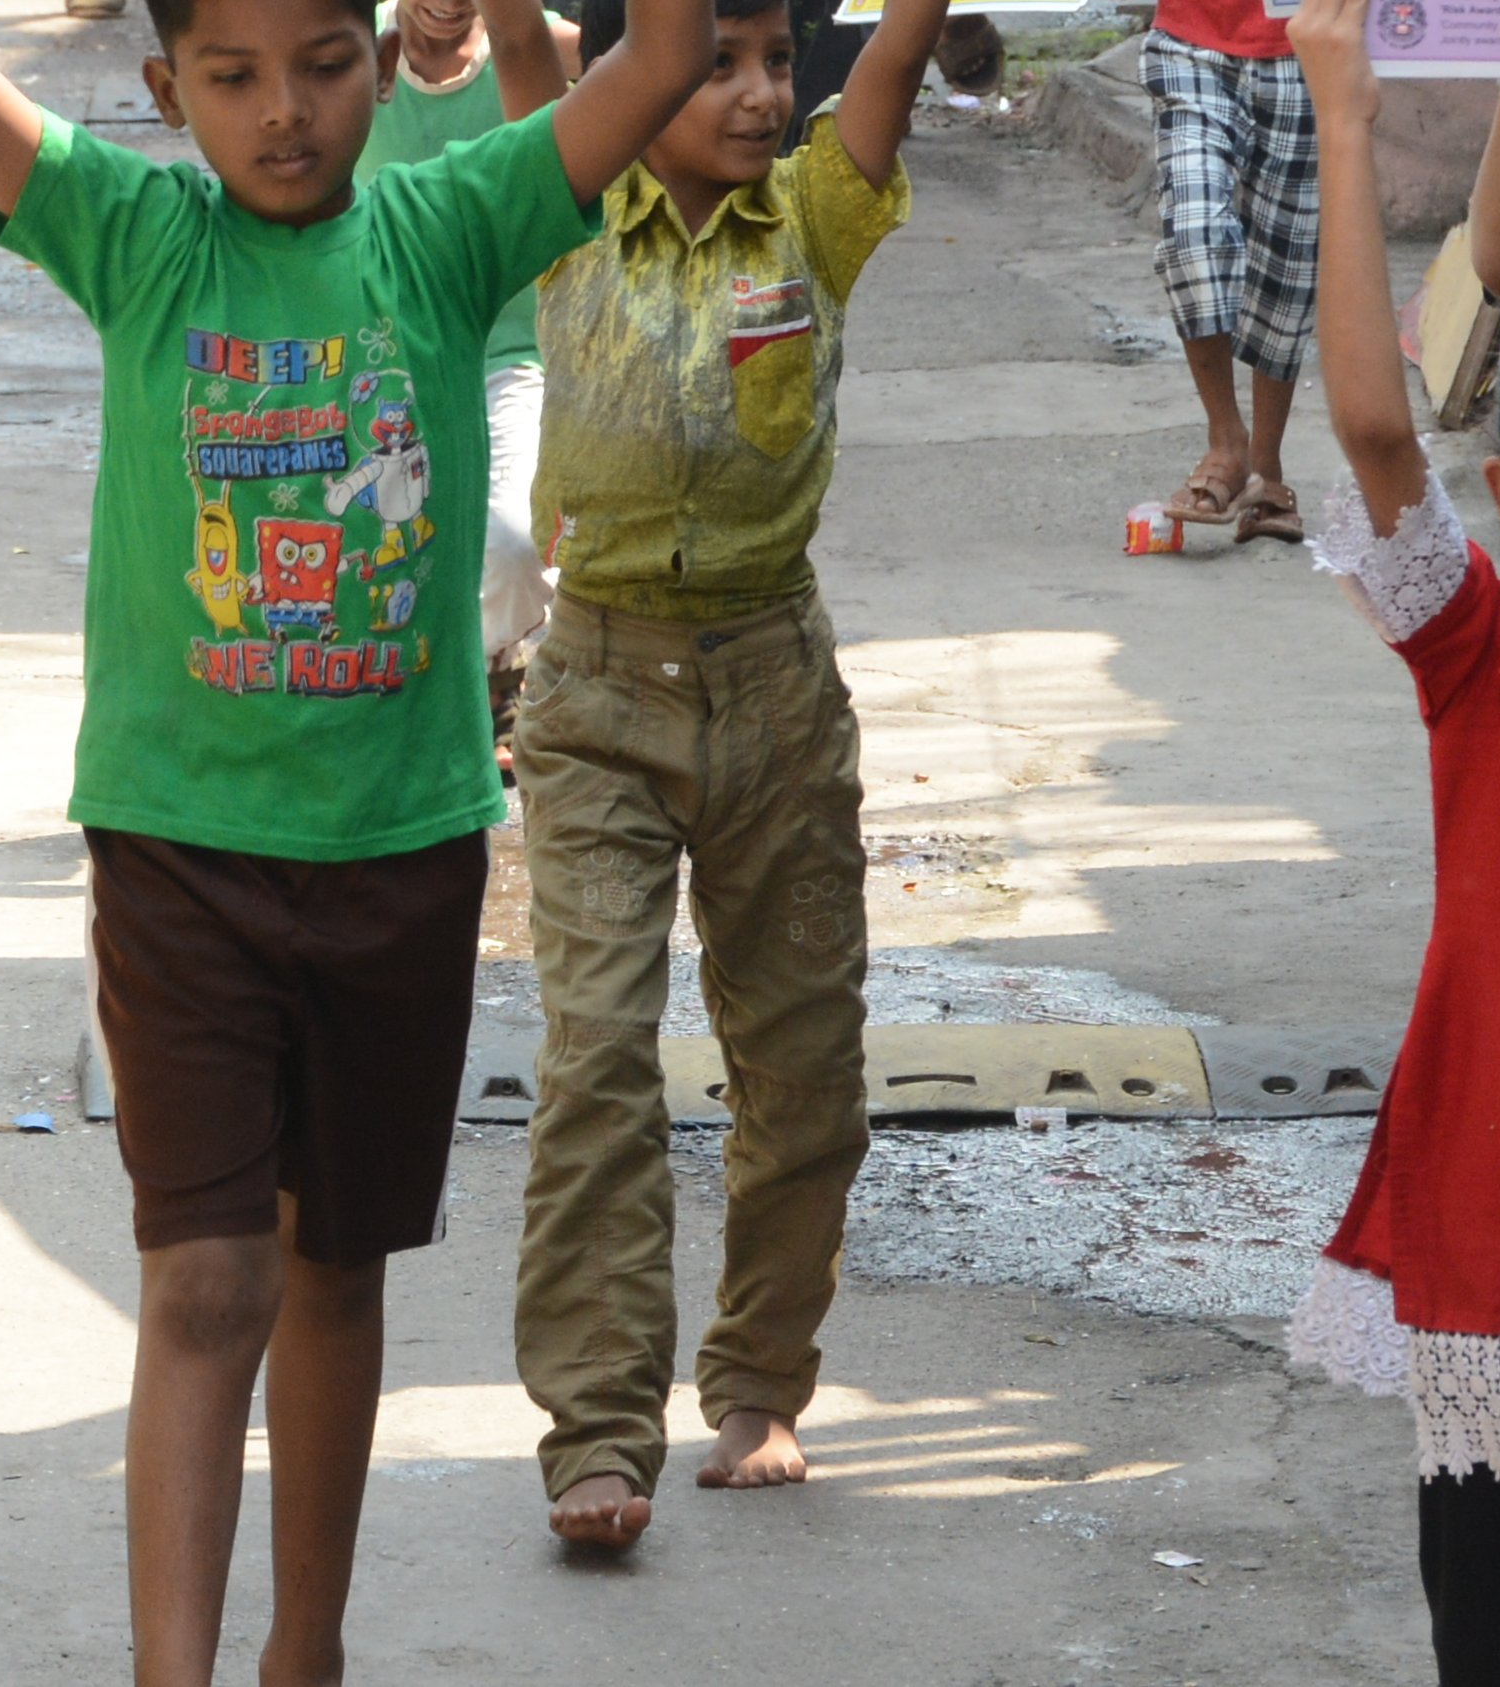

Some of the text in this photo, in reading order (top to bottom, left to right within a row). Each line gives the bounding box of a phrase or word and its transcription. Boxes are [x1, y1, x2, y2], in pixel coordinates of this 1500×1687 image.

[1469, 4, 1500, 15] Award
[1441, 33, 1470, 46] Jointly
[186, 327, 347, 385] DEEP!
[205, 638, 408, 698] WE ROLL
